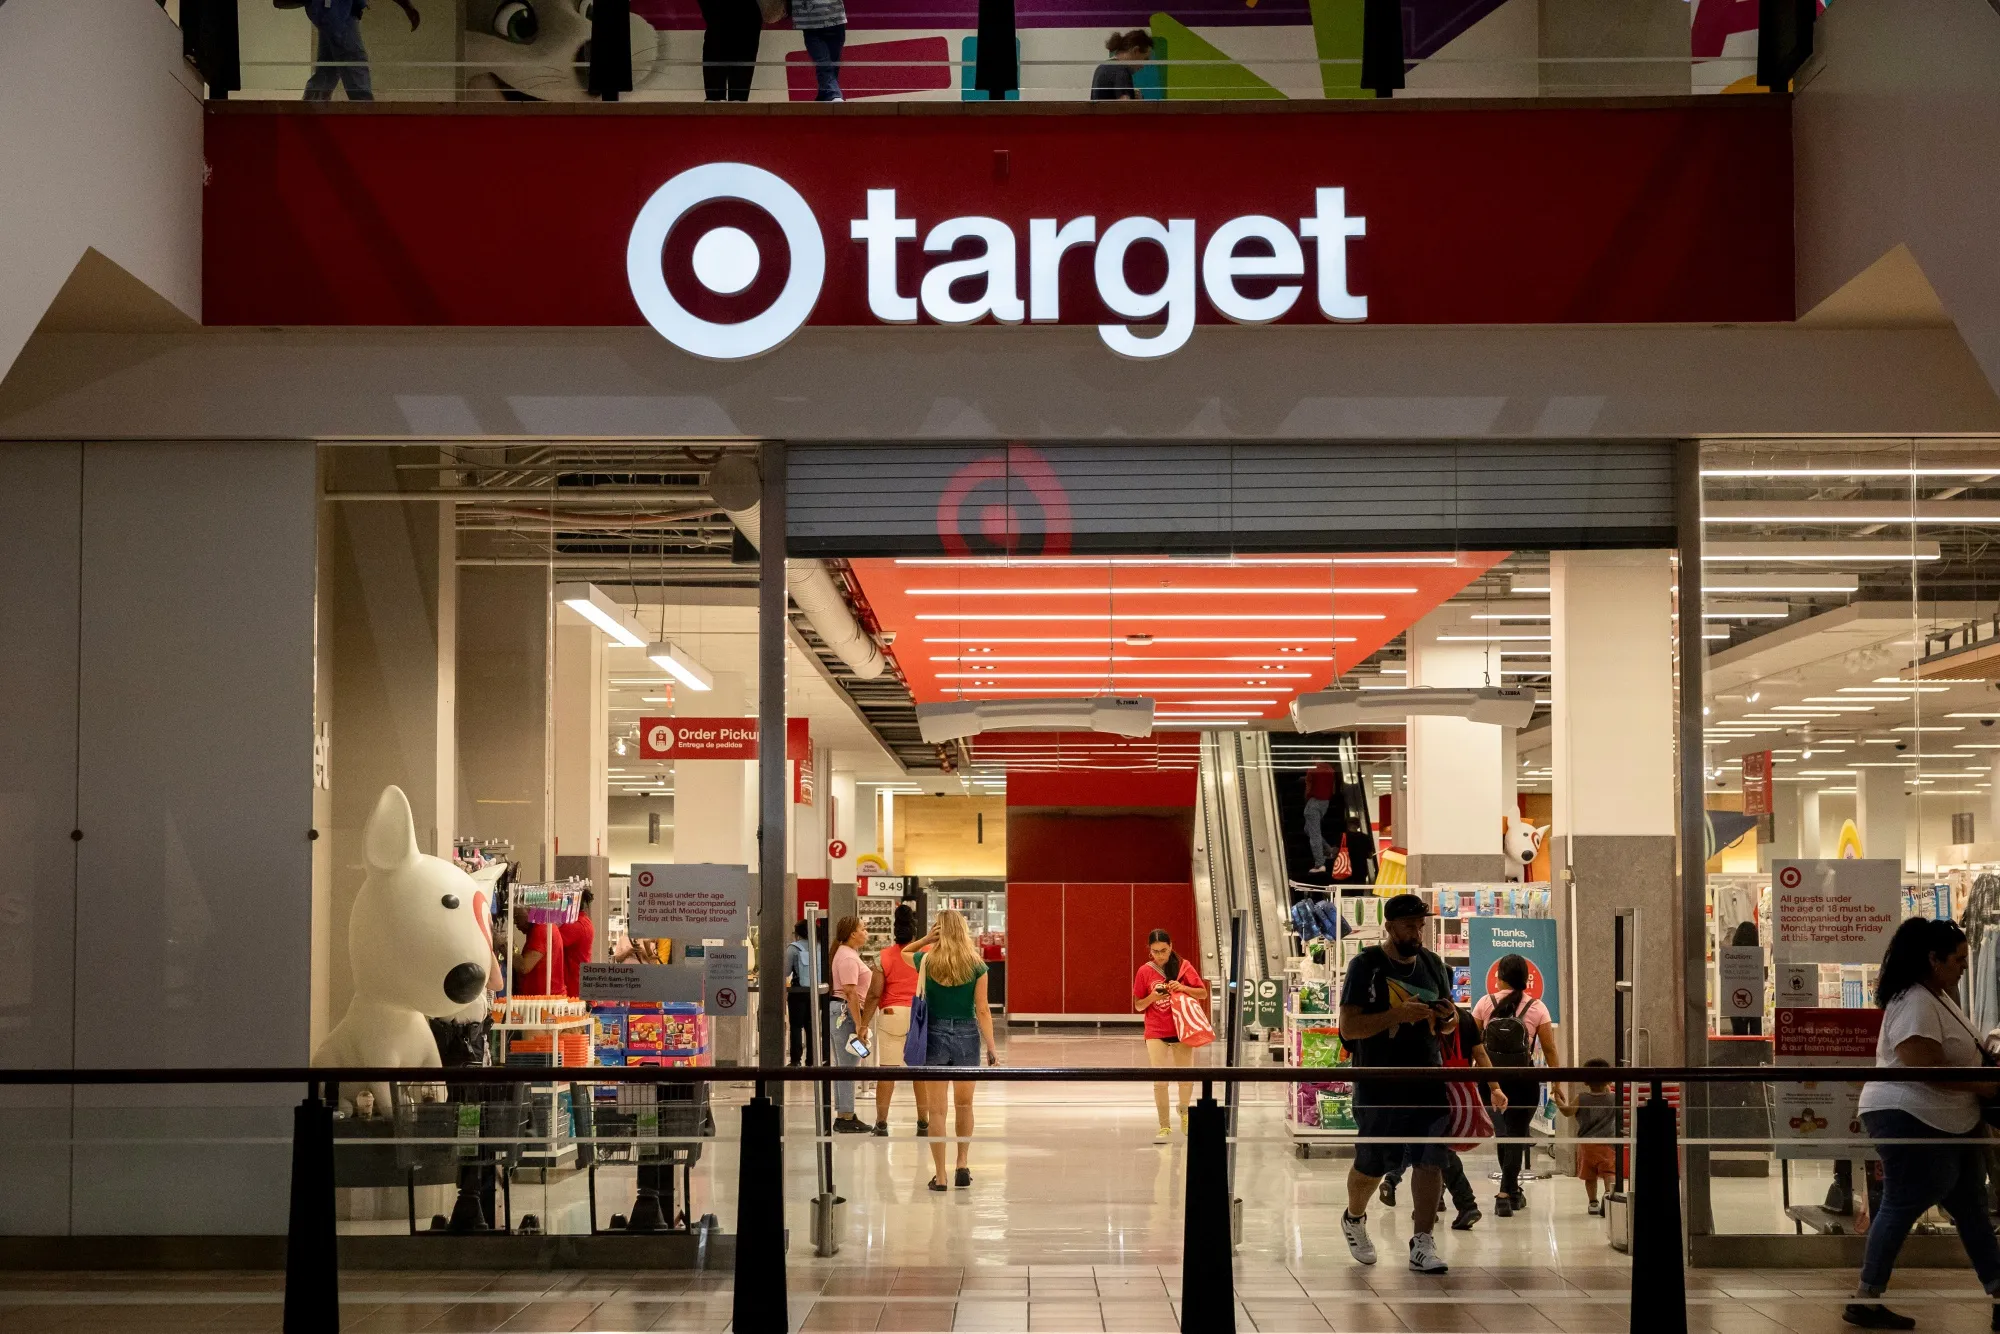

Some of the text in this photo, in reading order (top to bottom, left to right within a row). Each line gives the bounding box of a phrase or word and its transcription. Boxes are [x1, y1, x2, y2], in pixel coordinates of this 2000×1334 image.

[851, 186, 1368, 360] target
[678, 728, 717, 740] Order
[687, 900, 736, 908] accompanied
[1793, 895, 1823, 904] guests
[679, 908, 707, 916] Monday
[709, 908, 737, 916] through
[1797, 906, 1813, 914] age
[1781, 914, 1840, 923] accompanied
[1843, 914, 1853, 923] by
[1868, 914, 1891, 922] adult
[1491, 928, 1528, 938] Thanks,
[1781, 924, 1883, 933] Monday through Friday
[1810, 934, 1839, 943] Target
[1492, 939, 1535, 948] teachers!
[608, 966, 634, 974] Hours
[1781, 1026, 1796, 1034] Our
[1815, 1027, 1845, 1036] priority
[1826, 1044, 1866, 1052] members
